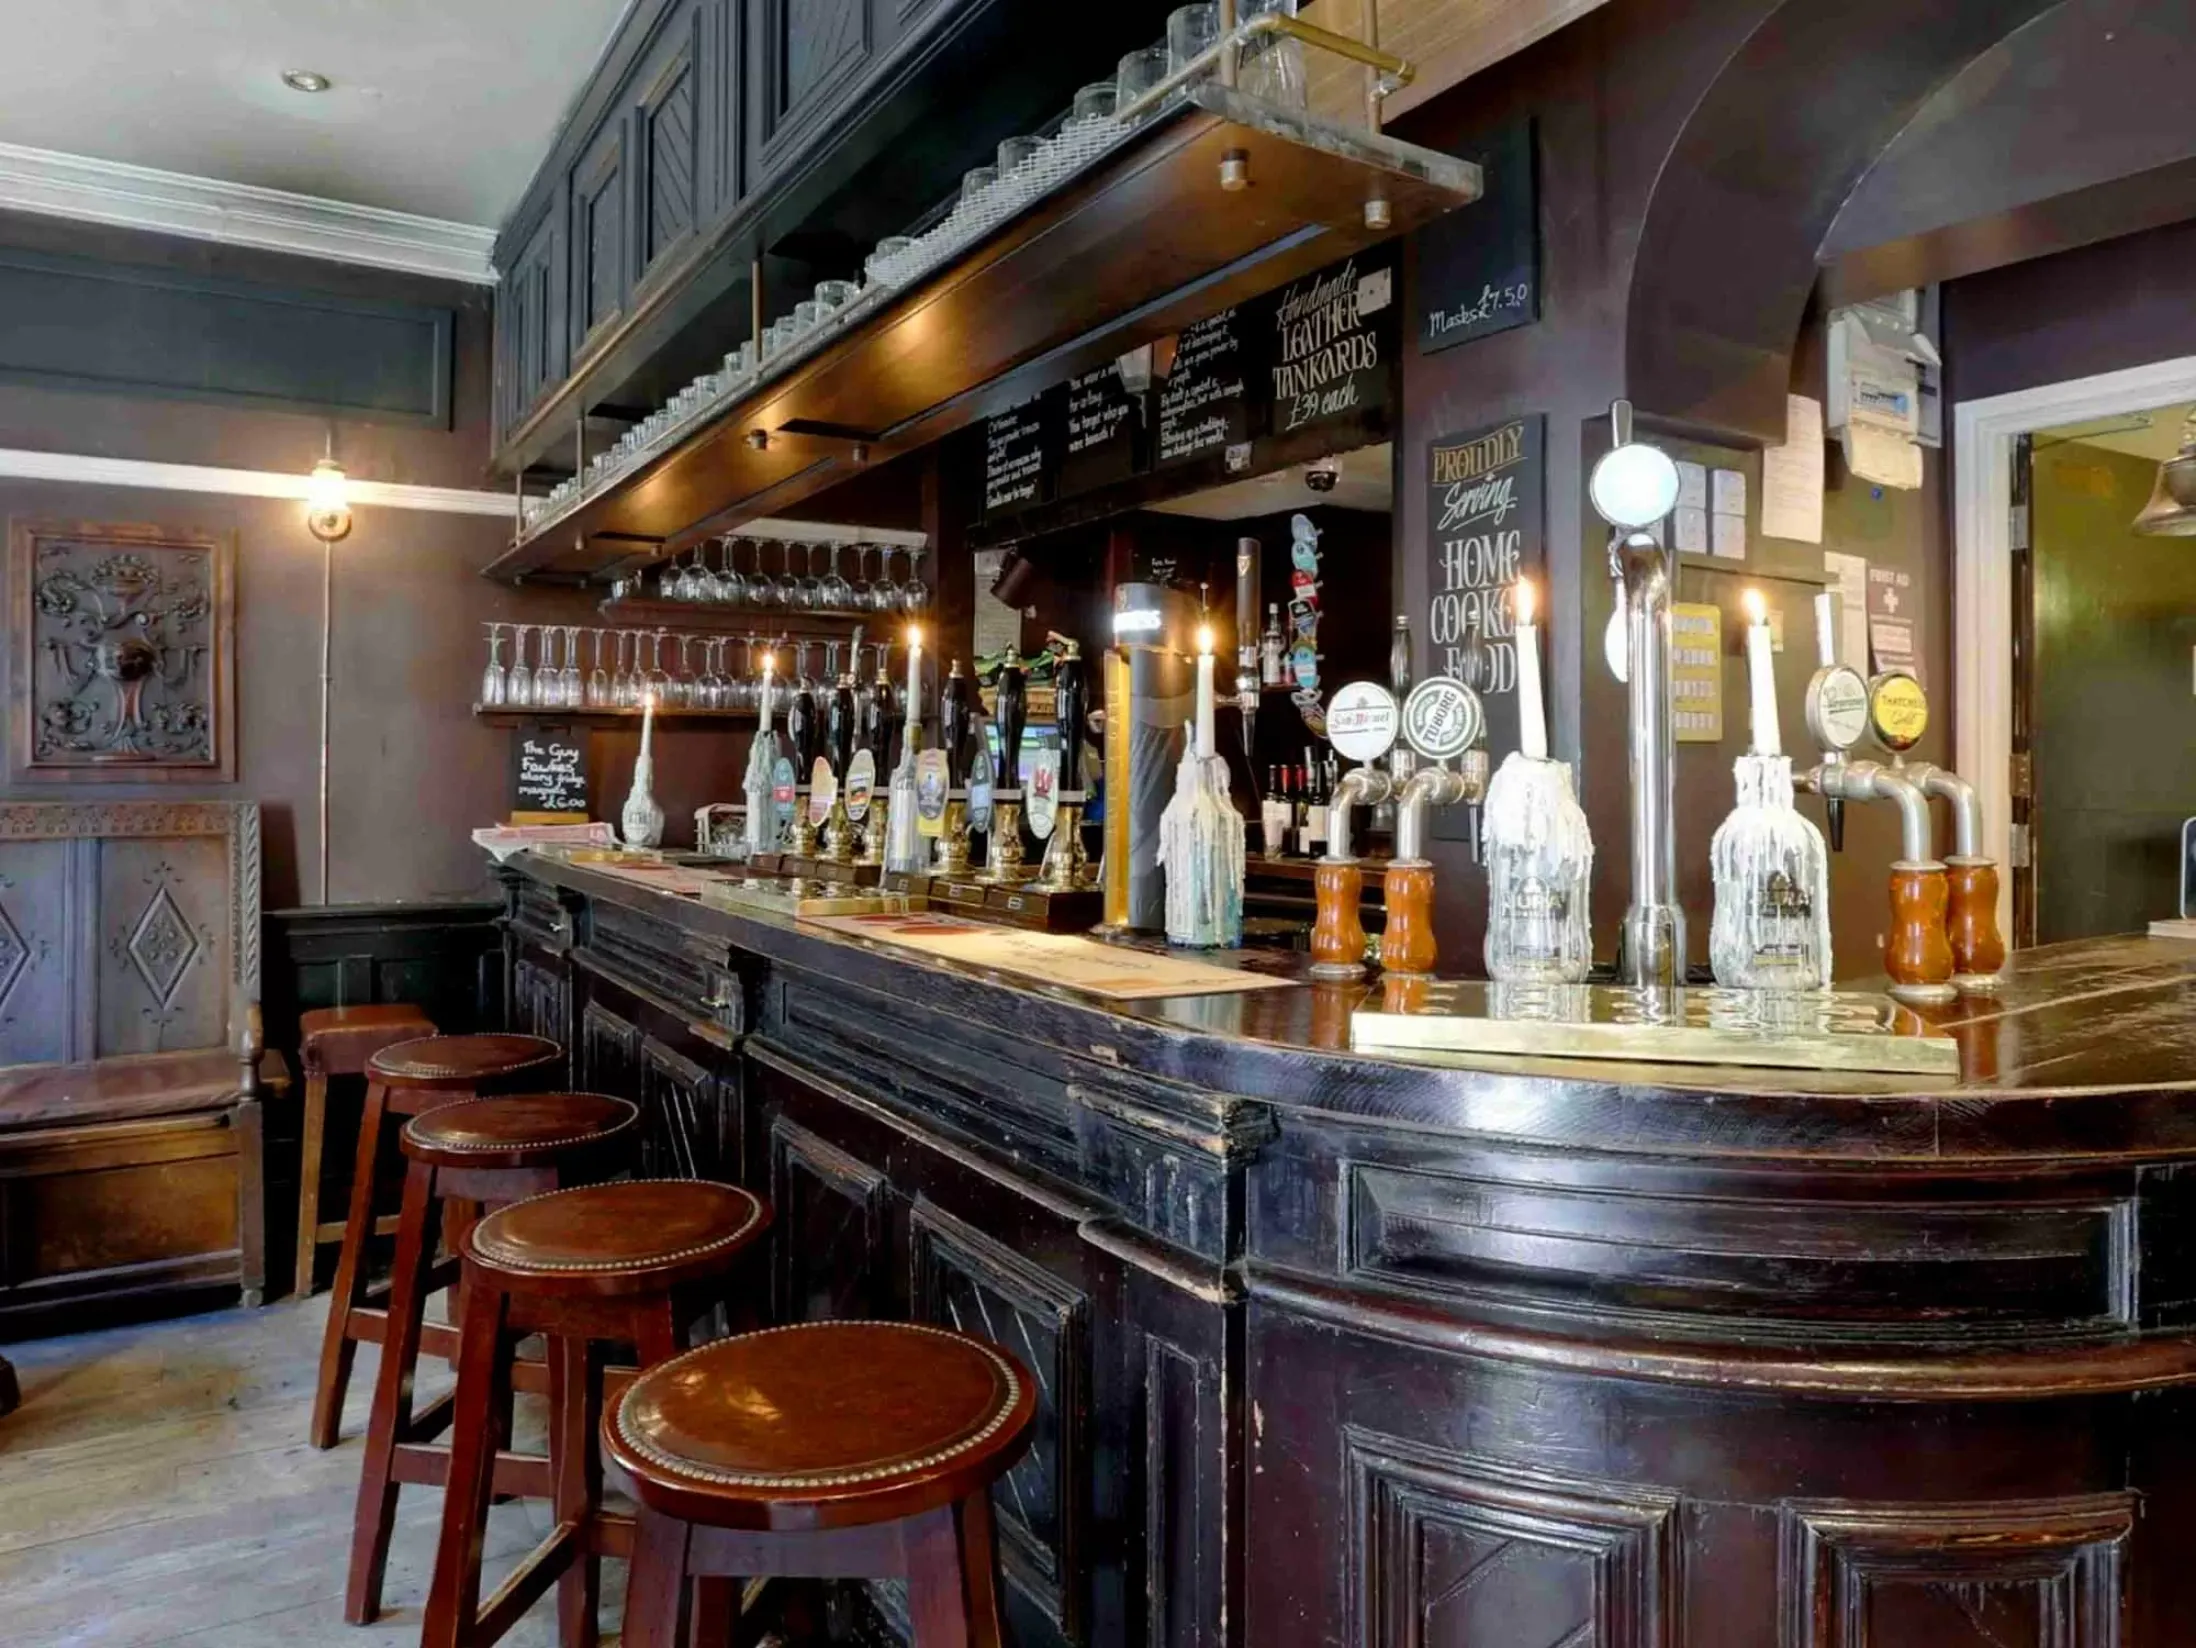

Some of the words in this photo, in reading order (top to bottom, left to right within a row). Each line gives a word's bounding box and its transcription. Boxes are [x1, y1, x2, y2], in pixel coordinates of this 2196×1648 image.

[1276, 259, 1357, 331] Handmade
[1282, 291, 1362, 362] LEATHER
[1272, 331, 1377, 400] TANKARDS
[1285, 391, 1318, 431] £39
[1321, 373, 1359, 415] each
[1432, 425, 1525, 483] PROUDLY
[1437, 472, 1518, 531] Serving
[1439, 529, 1521, 591] HOME
[1430, 587, 1520, 644] COOKE
[1423, 690, 1457, 744] TUBORG
[523, 740, 545, 755] The
[549, 743, 579, 764] Guy
